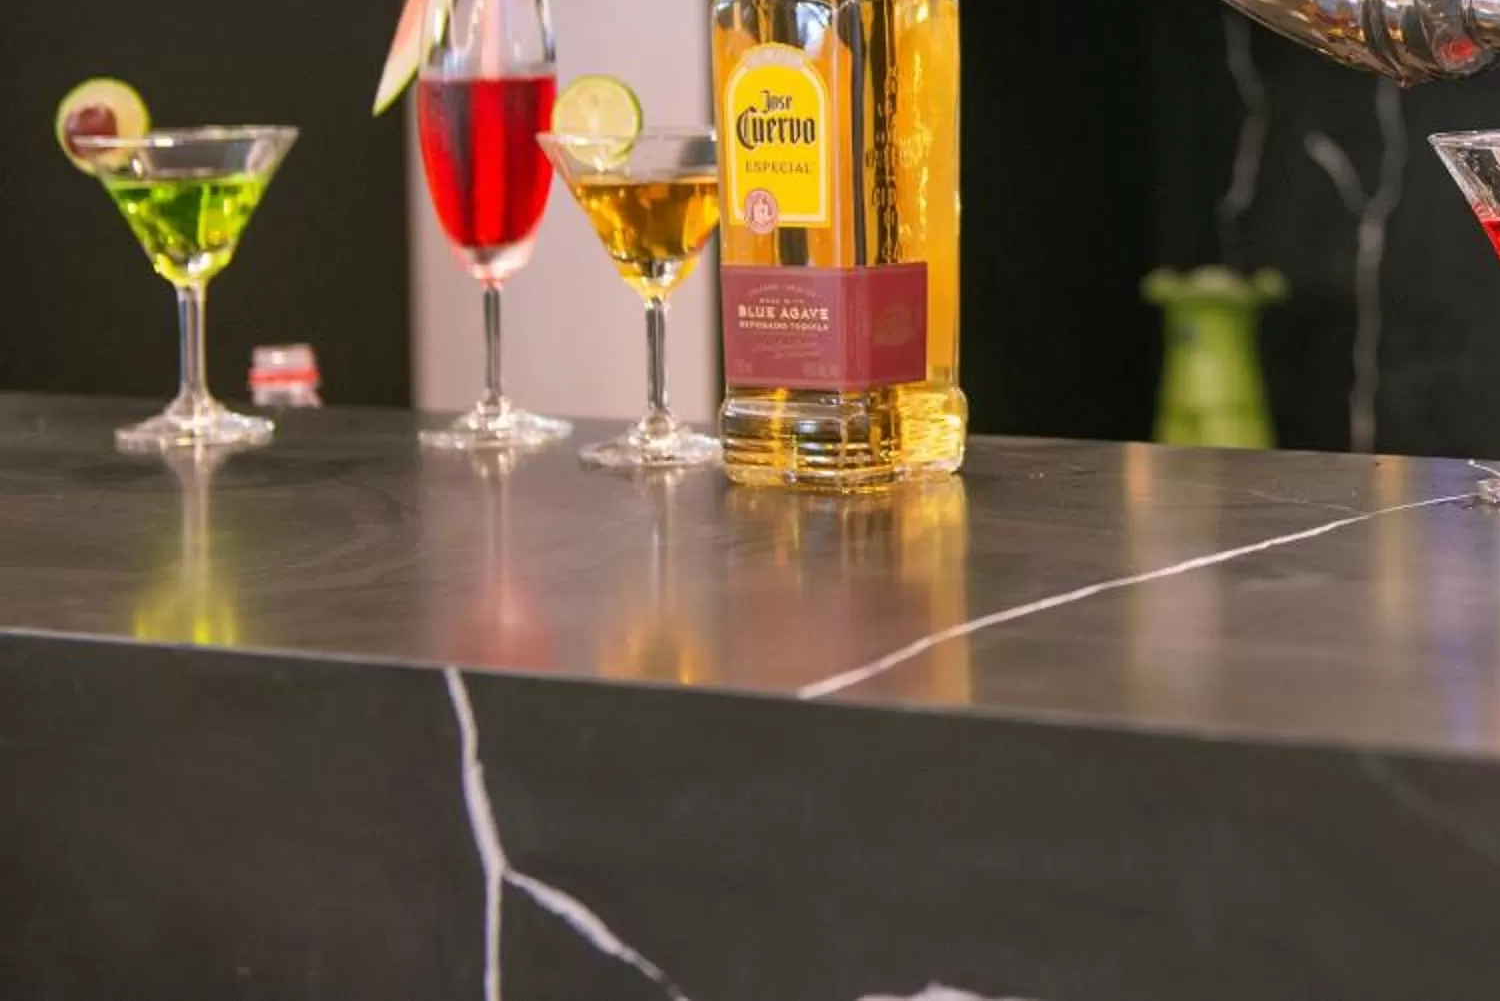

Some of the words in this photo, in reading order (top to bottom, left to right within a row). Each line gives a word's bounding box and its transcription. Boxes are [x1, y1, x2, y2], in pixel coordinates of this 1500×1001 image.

[759, 89, 793, 114] Jose
[736, 105, 815, 151] Cuervo
[745, 159, 811, 175] ESPECIAL
[737, 303, 775, 319] BLUE
[780, 306, 829, 321] AGAVE
